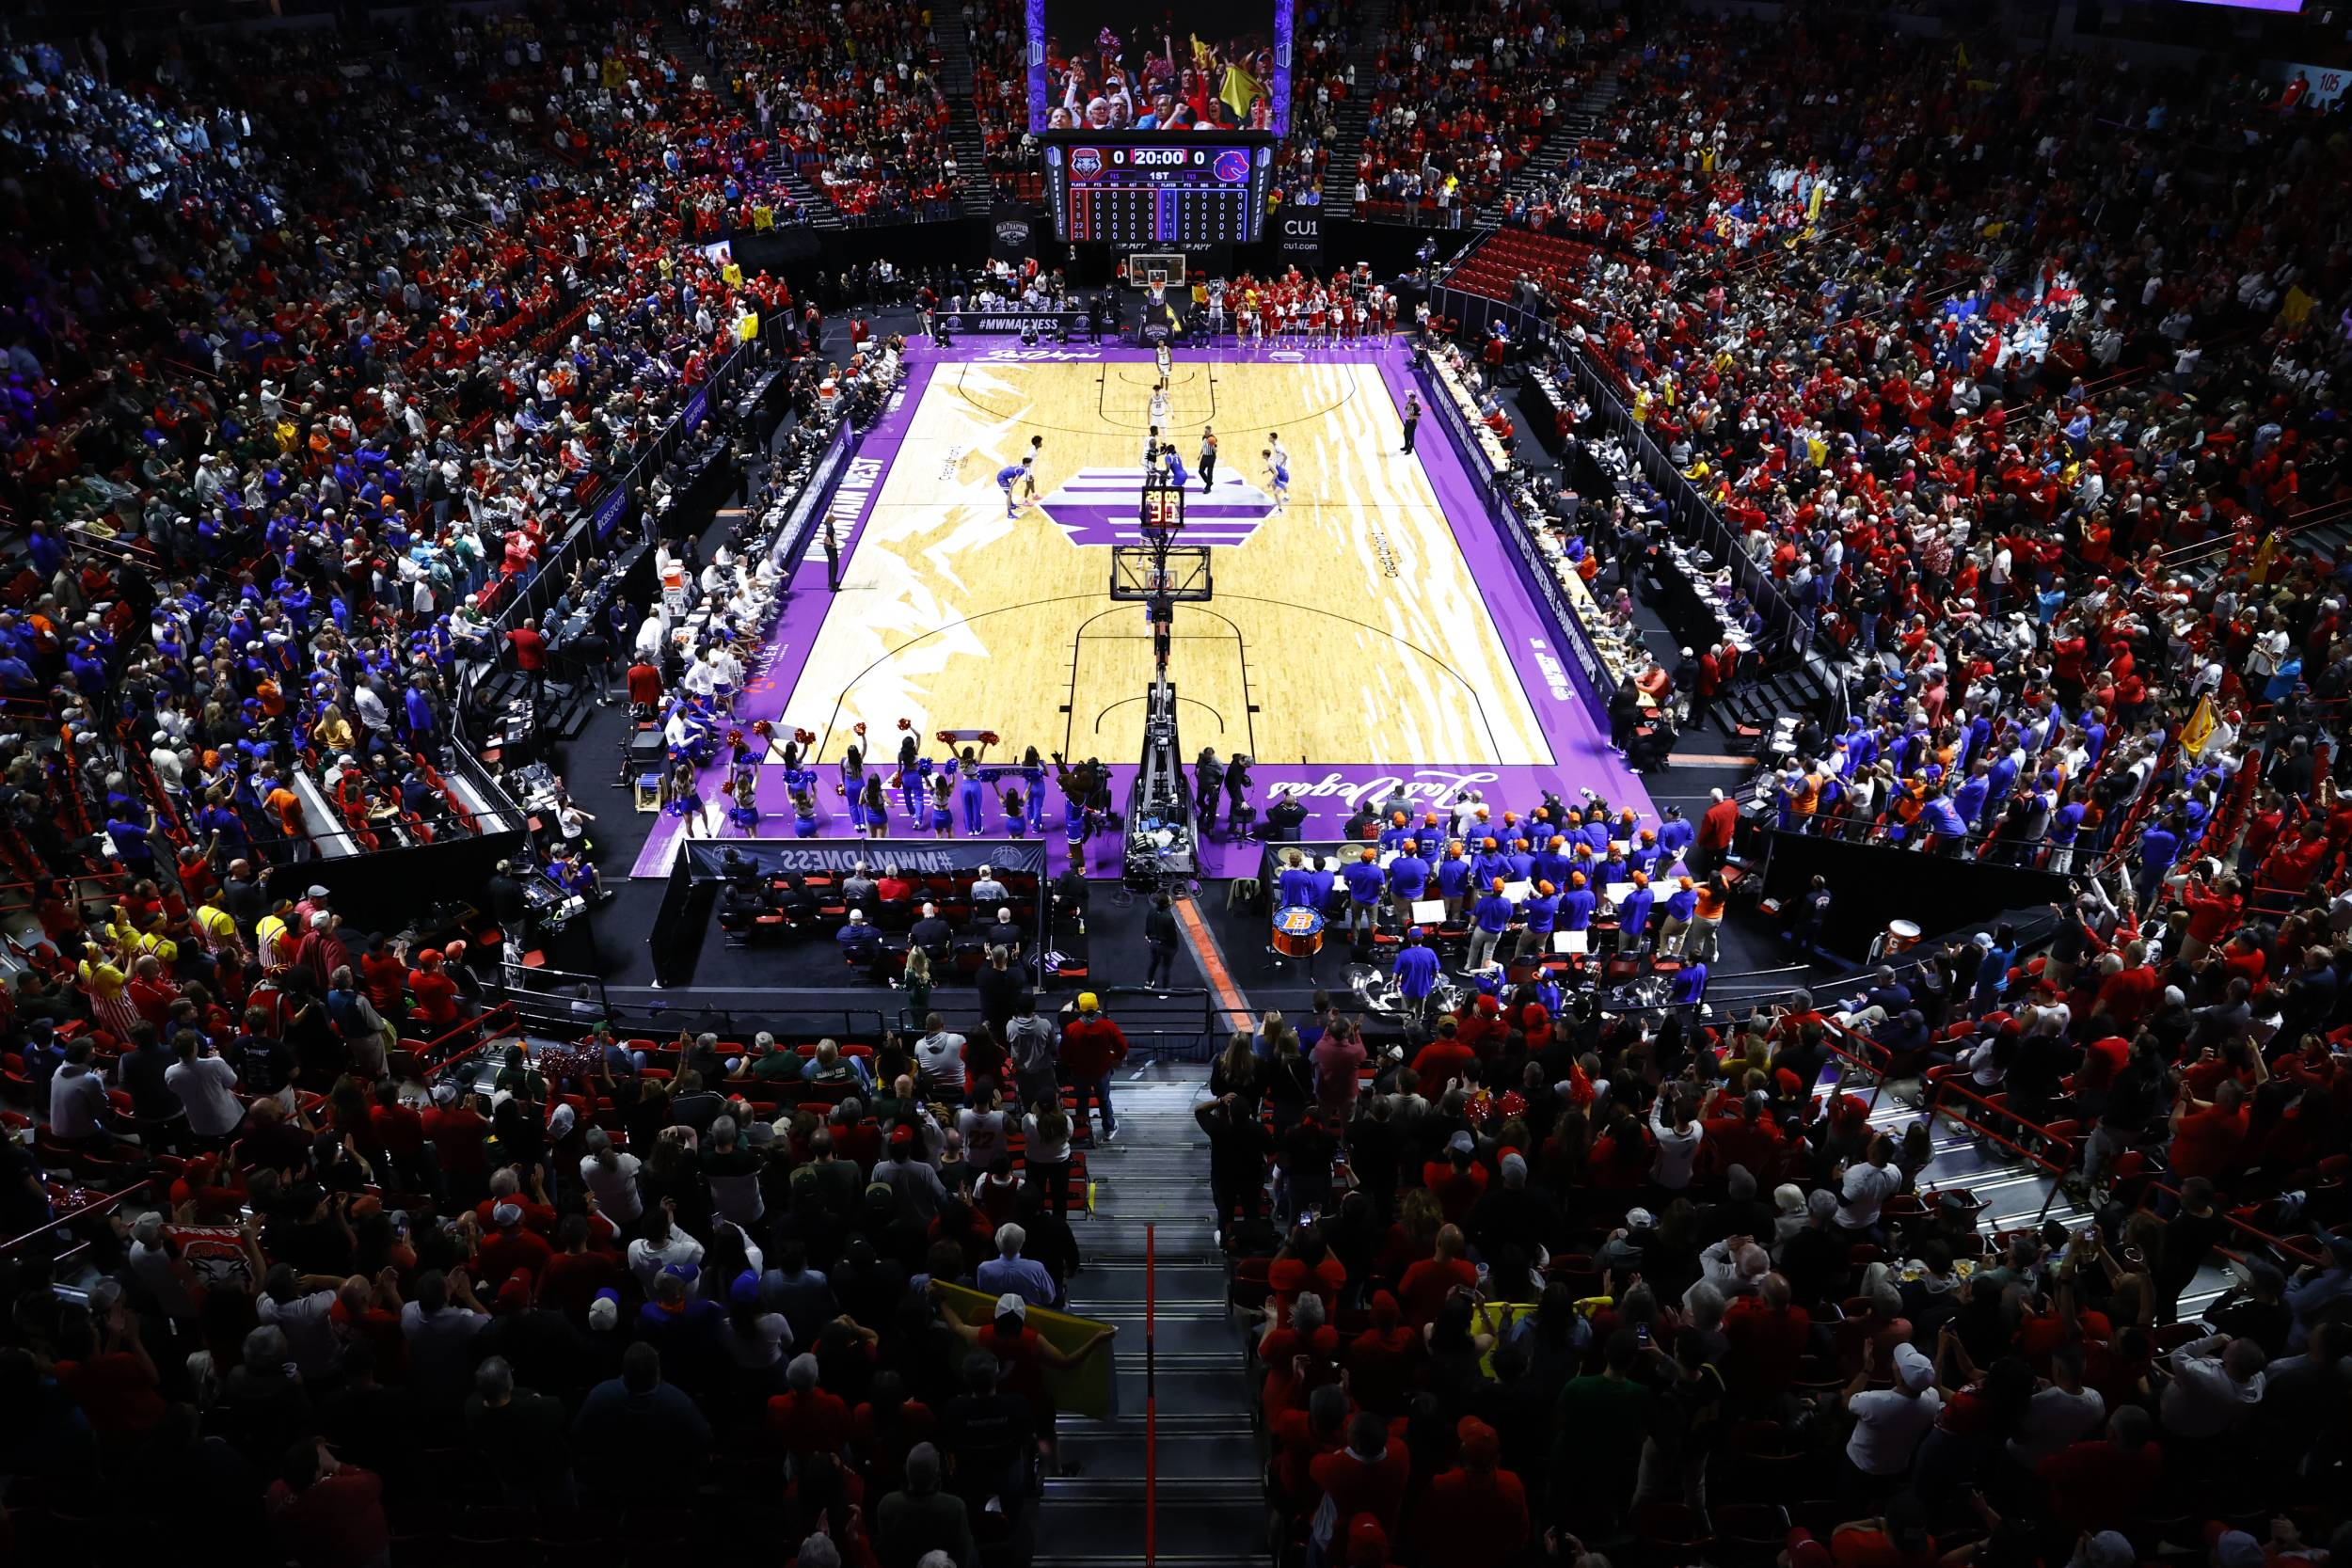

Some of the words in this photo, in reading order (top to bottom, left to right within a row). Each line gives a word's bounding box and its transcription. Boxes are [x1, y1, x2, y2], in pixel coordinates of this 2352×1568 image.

[2320, 73, 2341, 91] 105
[1113, 150, 1124, 165] 0
[1135, 150, 1184, 165] 20:00
[1194, 150, 1205, 165] 0
[1150, 172, 1169, 181] 1ST
[1095, 231, 1101, 240] 0
[1112, 231, 1118, 240] 0
[1130, 231, 1136, 240] 0
[1148, 231, 1153, 240] 0
[1184, 231, 1190, 240] 0
[1201, 231, 1206, 240] 0
[1219, 231, 1225, 240] 0
[1236, 231, 1242, 240] 0
[1284, 220, 1318, 235] CU1
[839, 456, 884, 488] WEST
[1146, 490, 1162, 502] 20
[1165, 490, 1180, 502] 00
[1150, 502, 1176, 523] 30
[1501, 499, 1521, 546] MOUNTAIN
[1519, 534, 1532, 563] WEST
[1530, 550, 1557, 612] BASKETBALL
[1555, 600, 1597, 684] CHAMPIONSHIPS
[1266, 772, 1404, 808] Vegas
